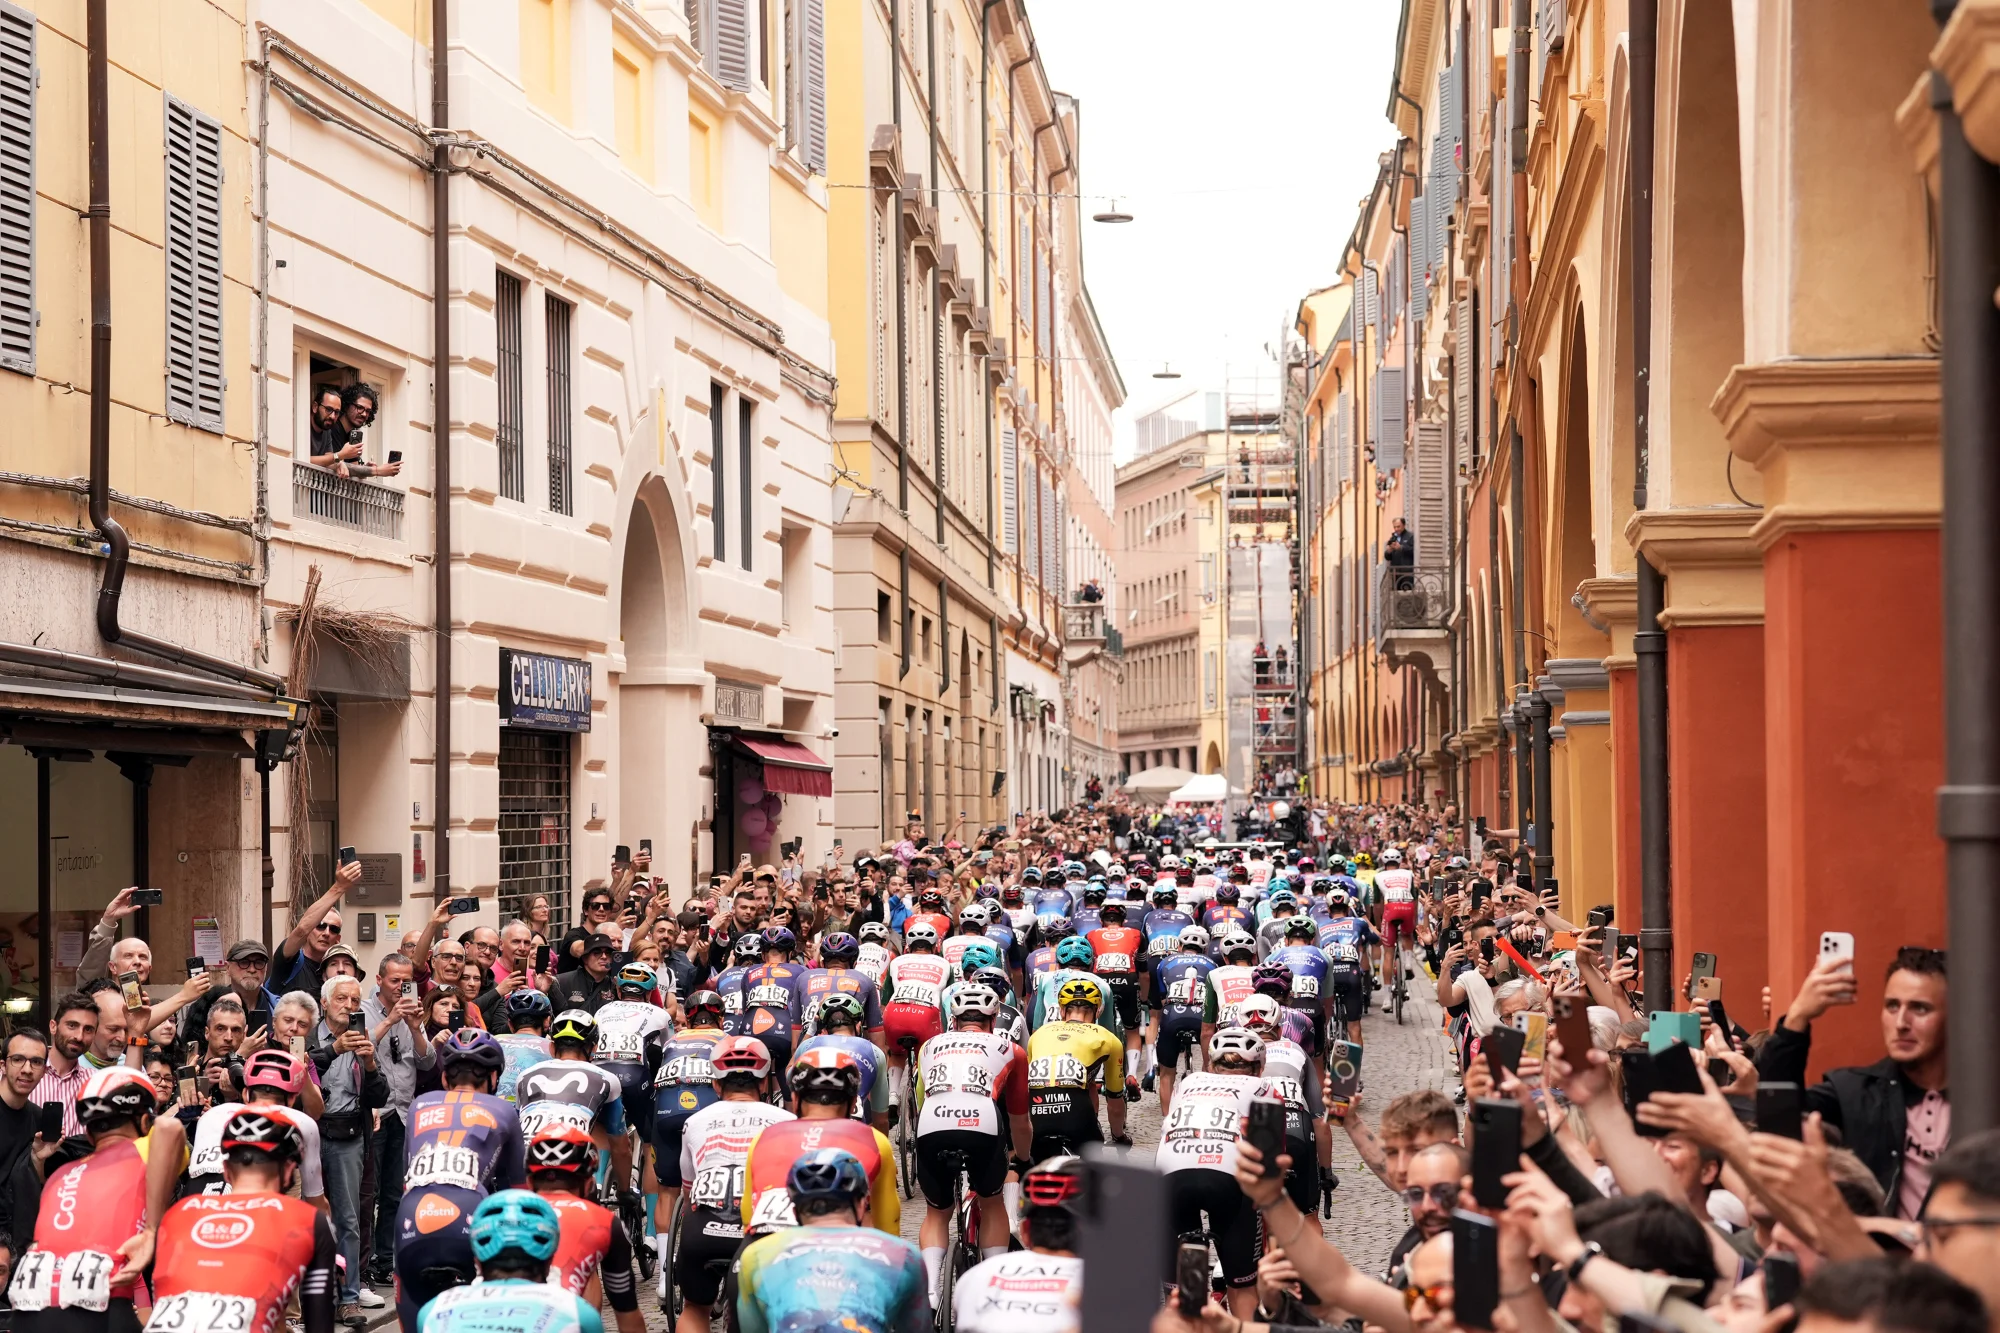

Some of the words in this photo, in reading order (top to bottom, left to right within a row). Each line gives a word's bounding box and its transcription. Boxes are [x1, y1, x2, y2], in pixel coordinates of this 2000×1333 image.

[511, 655, 584, 712] CELLULARK
[899, 962, 940, 972] POLTI
[1114, 954, 1127, 967] 28
[1173, 983, 1185, 997] 71
[1301, 978, 1315, 991] 56
[767, 987, 787, 1004] 164
[893, 1007, 925, 1015] AURUM
[620, 1034, 638, 1051] 38
[929, 1064, 948, 1086] 98
[968, 1065, 987, 1084] 98
[1029, 1059, 1050, 1077] 83
[1056, 1060, 1084, 1080] 183
[1045, 1093, 1071, 1102] VISMA
[934, 1105, 980, 1118] Circus
[1171, 1105, 1194, 1128] 97
[1209, 1106, 1235, 1129] 97
[522, 1114, 543, 1136] 22
[731, 1116, 776, 1128] UBS
[1169, 1130, 1194, 1139] TUDOR
[1206, 1131, 1234, 1141] TUDOR
[1172, 1139, 1223, 1154] Circus
[196, 1145, 221, 1165] 65
[1200, 1155, 1220, 1165] Daily
[440, 1151, 475, 1177] 161
[53, 1163, 89, 1231] Cofidis
[181, 1197, 283, 1211] ARKEA
[762, 1194, 791, 1221] 42
[201, 1222, 245, 1235] B&B
[705, 1221, 744, 1232] Q36.
[15, 1253, 43, 1290] 47
[72, 1252, 102, 1290] 47
[149, 1296, 189, 1331] 23
[208, 1299, 246, 1331] 23
